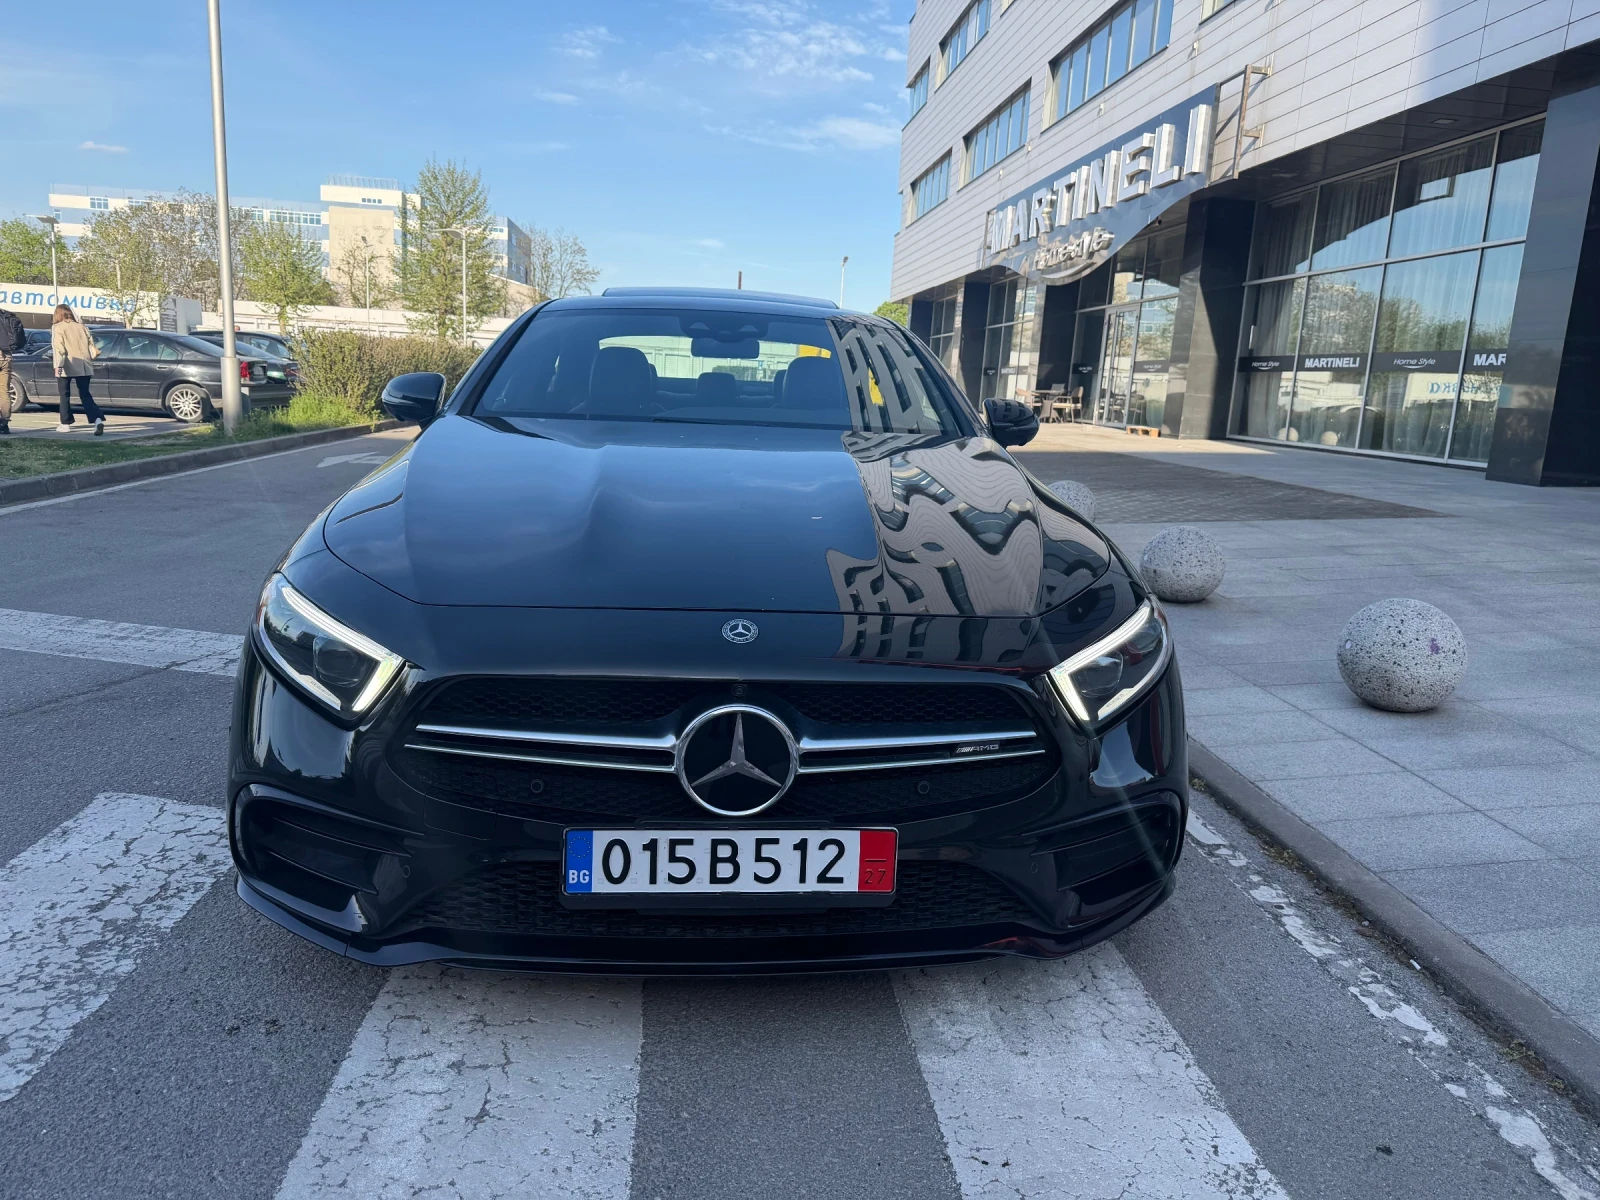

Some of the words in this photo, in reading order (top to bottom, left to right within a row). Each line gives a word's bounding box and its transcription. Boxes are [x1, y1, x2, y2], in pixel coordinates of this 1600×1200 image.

[990, 103, 1212, 255] MARTINELI
[1304, 357, 1360, 368] MARTINELI
[1418, 358, 1436, 366] Style
[970, 743, 999, 752] AMG
[602, 837, 845, 885] 015B512
[568, 870, 590, 884] BG
[864, 868, 887, 885] 27
